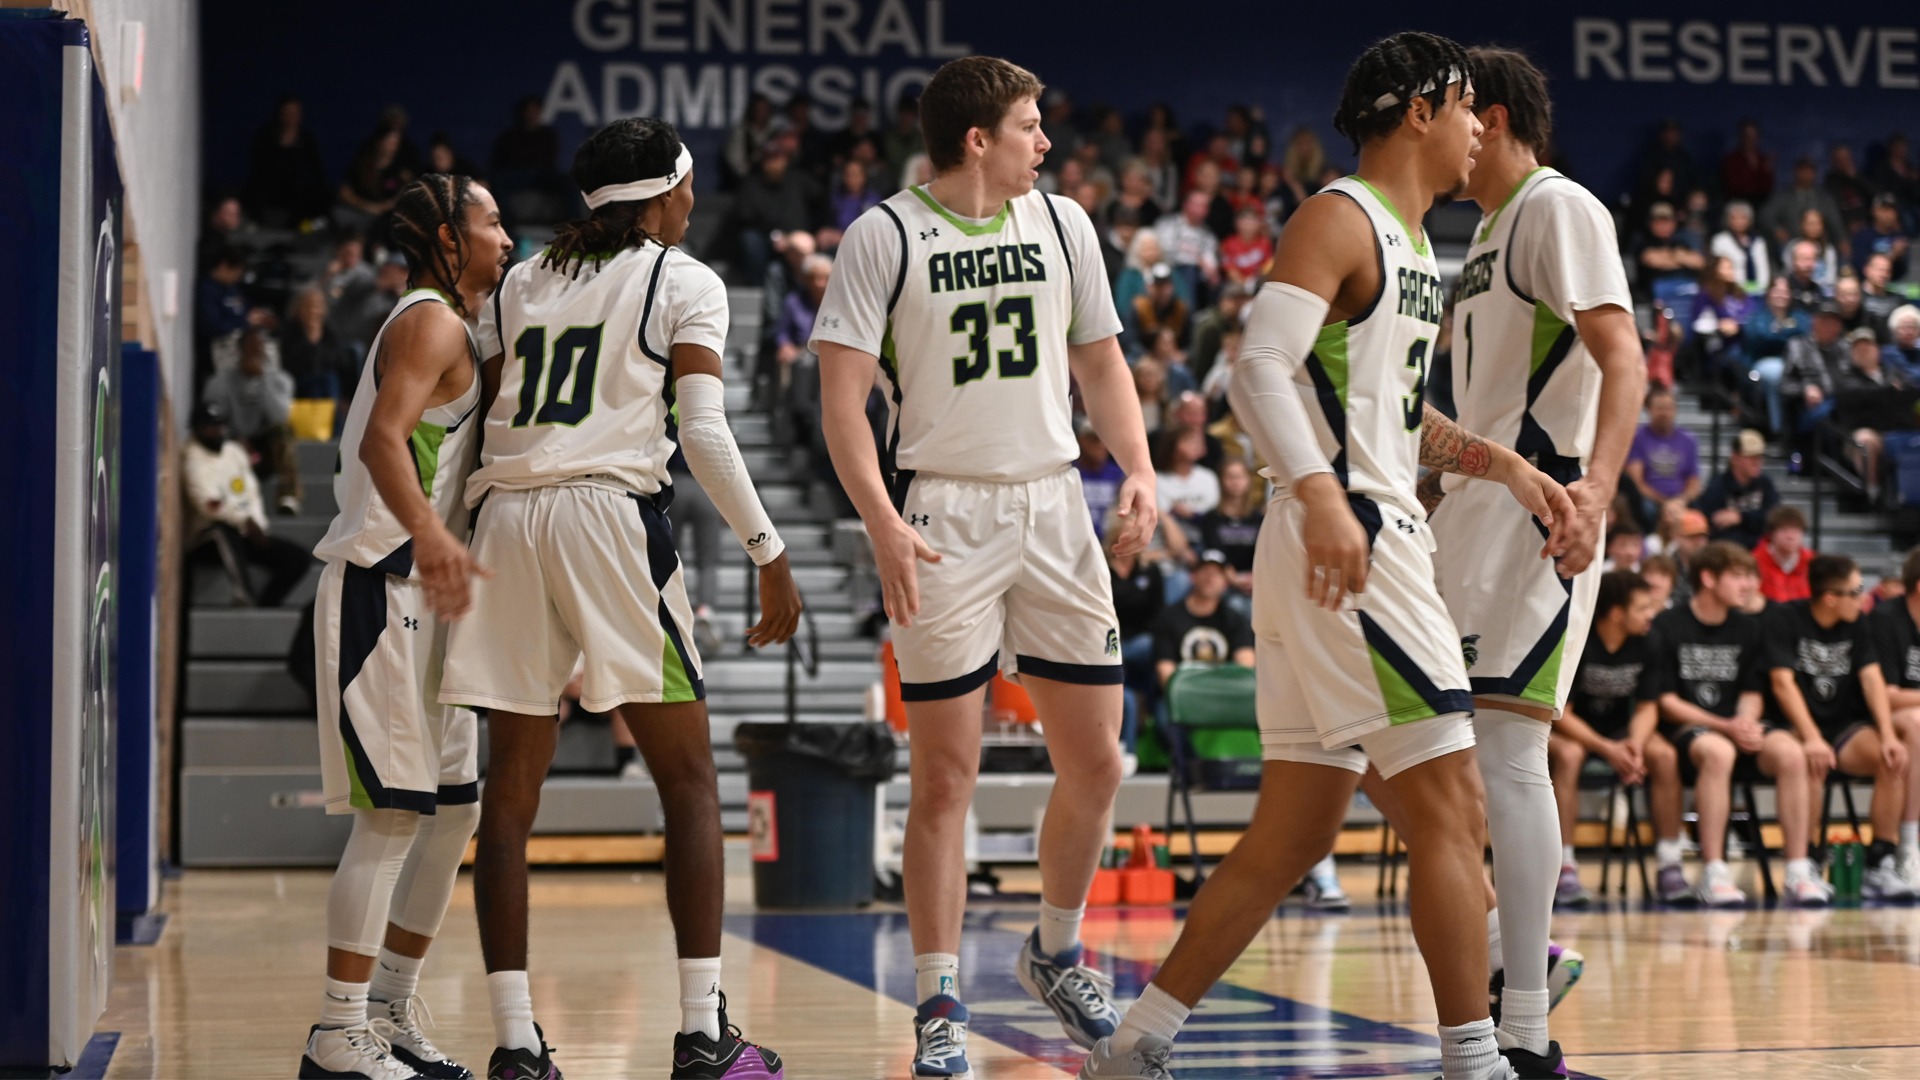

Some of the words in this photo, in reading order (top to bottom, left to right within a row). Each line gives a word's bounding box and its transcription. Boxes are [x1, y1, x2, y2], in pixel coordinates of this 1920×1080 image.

[572, 0, 972, 58] GENERAL
[1573, 18, 1920, 89] RESERVE
[928, 243, 1047, 293] ARGOS
[508, 320, 606, 429] 10
[949, 295, 1039, 387] 33
[1403, 335, 1430, 434] 3
